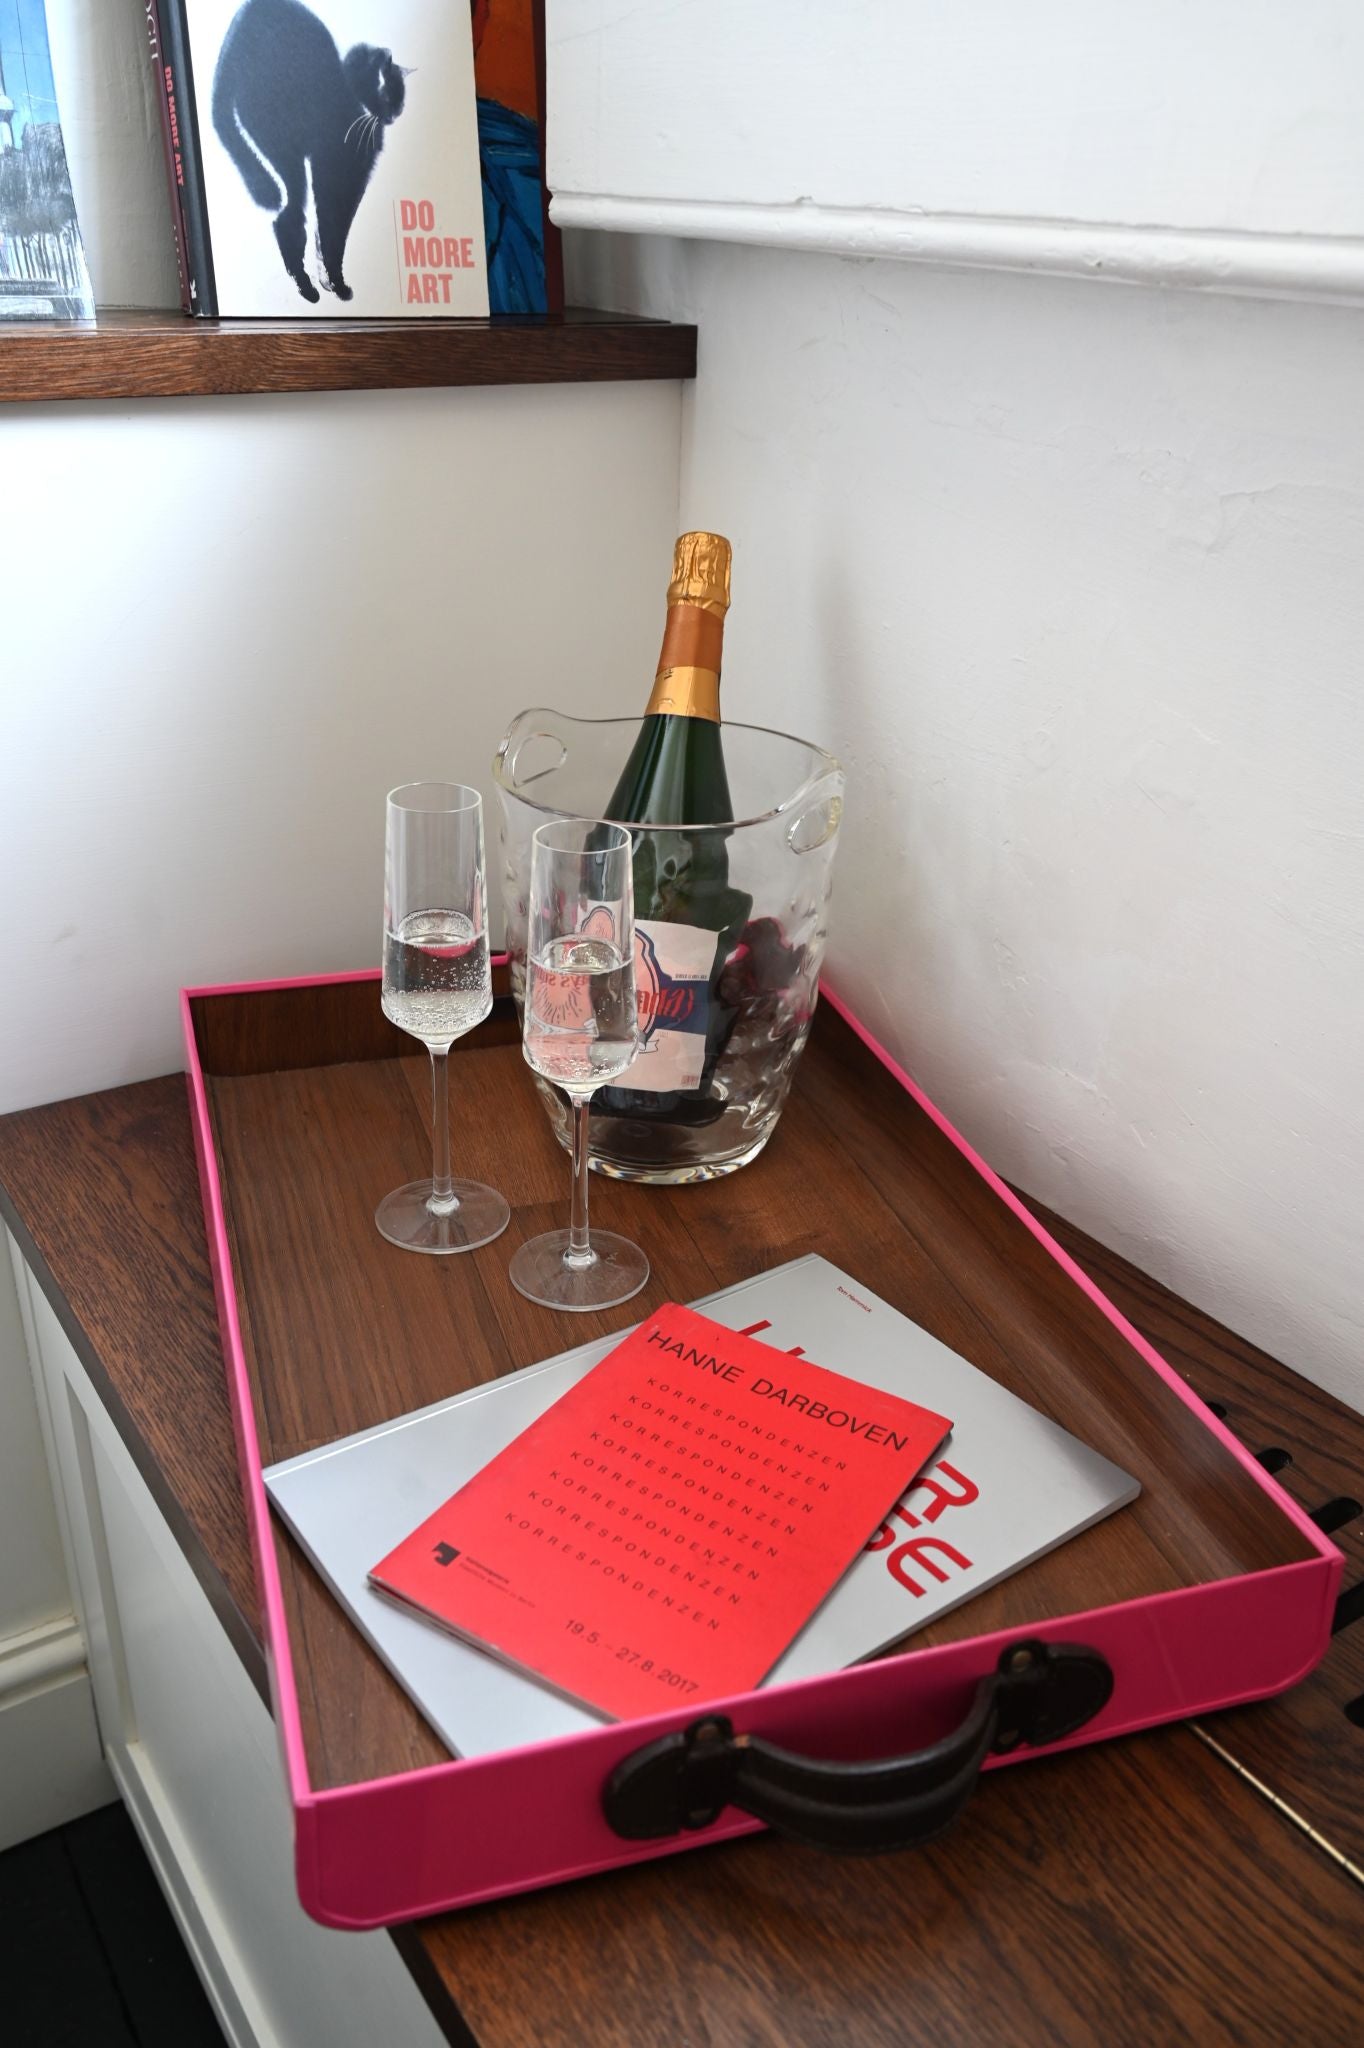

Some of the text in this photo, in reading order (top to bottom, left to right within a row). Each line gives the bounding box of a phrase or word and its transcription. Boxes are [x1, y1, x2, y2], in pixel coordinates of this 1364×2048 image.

[164, 66, 184, 186] DO MORE ART
[400, 200, 435, 231] DO
[403, 237, 475, 268] MORE
[407, 274, 453, 304] ART
[647, 1330, 745, 1384] HANNE
[750, 1378, 909, 1452] DARBOVEN
[648, 1378, 846, 1470] KORRESPONDENZEN
[590, 1432, 795, 1535] KORRESPONDENZEN
[610, 1413, 813, 1513] KORRESPONDENZEN
[629, 1395, 829, 1491] KORRESPONDENZEN
[529, 1491, 740, 1604] KORRESPONDENZEN
[550, 1471, 759, 1580] KORRESPONDENZEN
[571, 1451, 778, 1557] KORRESPONDENZEN
[505, 1513, 719, 1630] KORRESPONDENZEN
